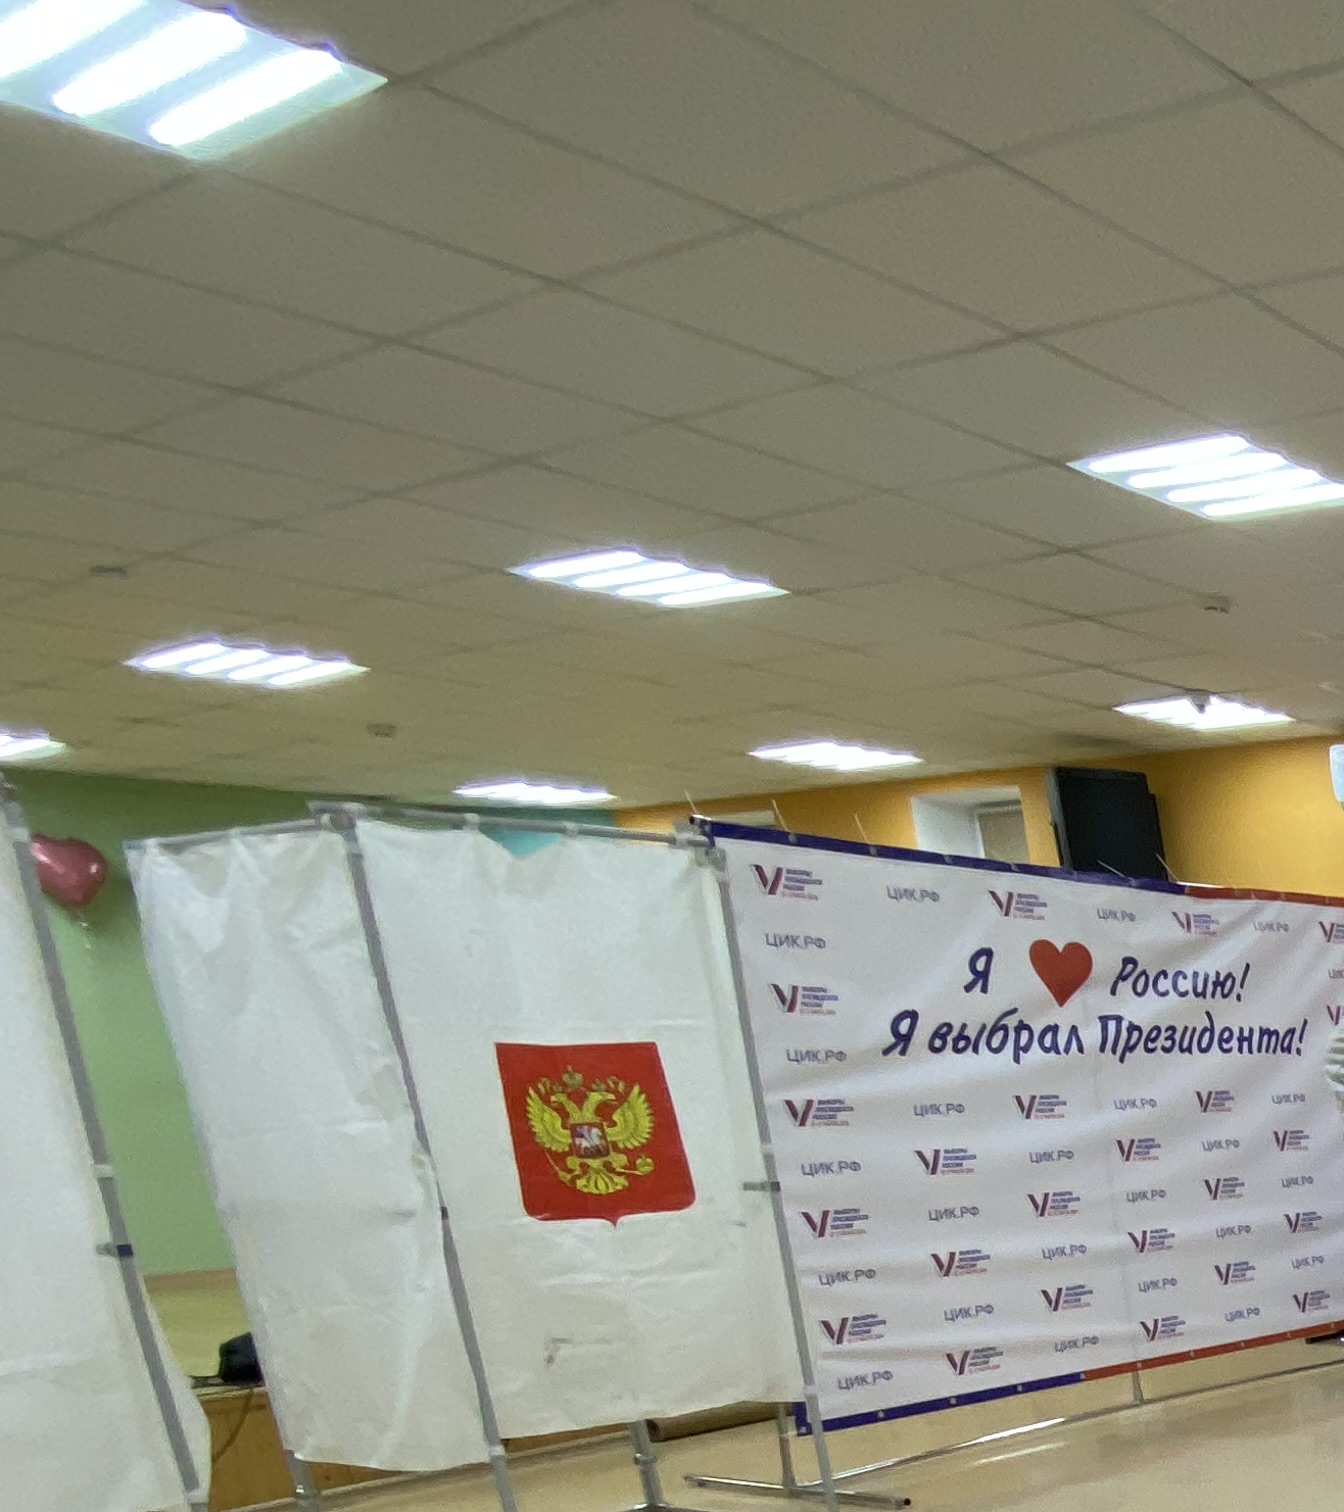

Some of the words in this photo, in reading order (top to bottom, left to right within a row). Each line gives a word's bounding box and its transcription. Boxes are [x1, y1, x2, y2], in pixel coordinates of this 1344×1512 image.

[963, 947, 994, 994] Я
[1110, 956, 1250, 1003] Россию!
[882, 1009, 919, 1057] Я
[928, 1007, 1085, 1065] выбрал
[1098, 1010, 1308, 1063] Президента!
